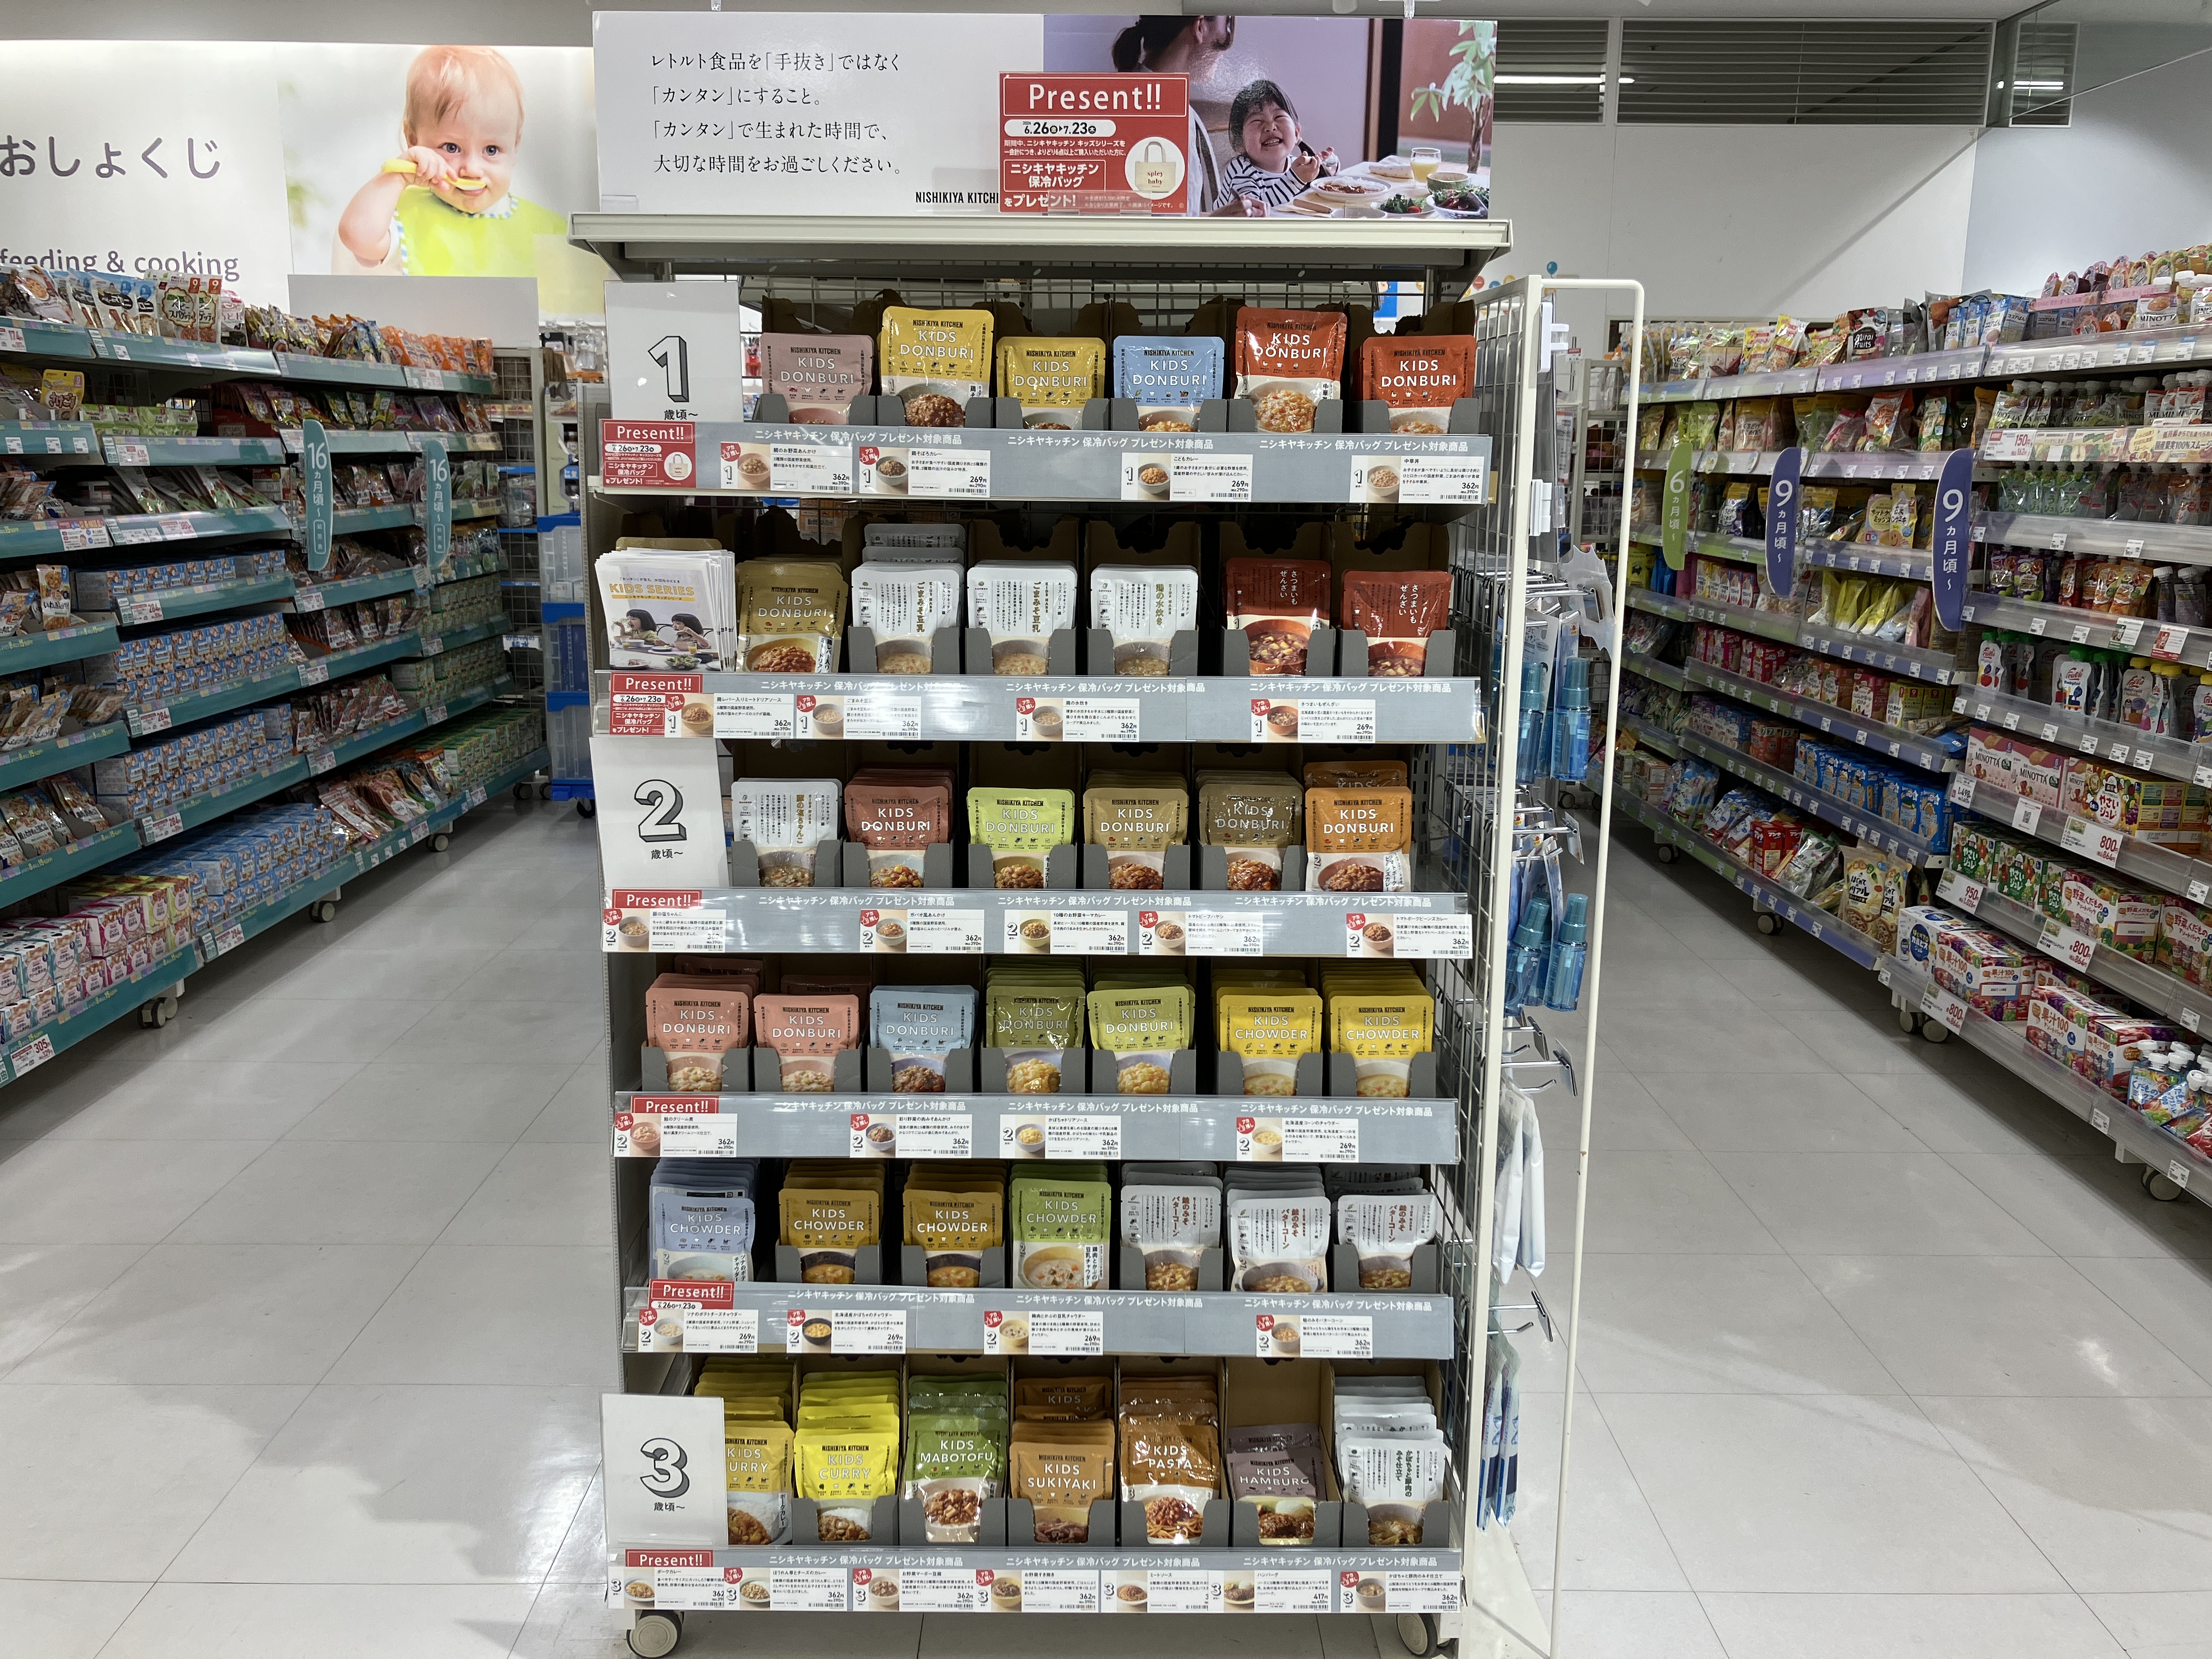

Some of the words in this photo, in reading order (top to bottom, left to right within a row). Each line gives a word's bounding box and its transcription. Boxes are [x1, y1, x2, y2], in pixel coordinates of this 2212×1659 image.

[652, 52, 899, 72] レトルト食品を「手抜き」ではなく
[654, 86, 819, 105] 「カンタン」にすること。
[1029, 84, 1161, 111] Present!!
[654, 121, 887, 139] 「カンタン」で生まれた時間で、
[0, 135, 220, 179] おしょくじ
[654, 154, 900, 174] 大切な時間をお過ごしください。
[1010, 163, 1099, 175] ニシキヤキッチン
[1029, 176, 1084, 188] 保冷バッグ
[916, 192, 964, 203] NISHIKIYA
[967, 192, 998, 204] KITCH
[1005, 194, 1076, 207] をプレゼント!
[107, 250, 125, 273] &
[134, 251, 240, 282] cooking
[918, 330, 957, 343] KIDS
[900, 344, 974, 360] DONBURI
[647, 335, 690, 402] 1
[798, 357, 836, 369] KIDS
[1150, 359, 1188, 371] KIDS
[780, 370, 855, 385] DONBURI
[1132, 374, 1206, 386] DONBURI
[617, 425, 685, 441] Present!!
[755, 430, 827, 441] ニシキヤキッチン
[830, 432, 877, 442] 保冷バッグ
[879, 432, 962, 445] プレゼント対象商品
[1260, 440, 1332, 450] ニシキヤキッチン
[1334, 440, 1381, 451] 保冷バッグ
[1384, 440, 1468, 452] プレゼント対象商品
[610, 583, 644, 594] KIDS
[647, 584, 695, 596] SERIES
[1279, 570, 1288, 599] ぜんざい
[776, 595, 811, 606] KIDS
[758, 608, 827, 618] DONBURI
[625, 677, 692, 691] Present!!
[1250, 682, 1320, 692] ニシキヤキッチン
[1322, 682, 1367, 692] 保冷バッグ
[1369, 682, 1451, 693] プレゼント対象商品
[634, 779, 687, 843] 2
[878, 807, 914, 818] KIDS
[1118, 808, 1153, 819] KIDS
[861, 820, 930, 831] DONBURI
[1100, 822, 1169, 833] DONBURI
[627, 895, 691, 907] Present!!
[997, 896, 1066, 906] ニシキヤキッチン
[1068, 896, 1111, 906] 保冷バッグ
[1114, 896, 1192, 906] プレゼント対象商品
[679, 1009, 715, 1020] KIDS
[1254, 1015, 1289, 1026] KIDS
[663, 1023, 730, 1035] DONBURI
[1234, 1028, 1308, 1040] CHOWDER
[646, 1101, 709, 1113] Present!!
[1008, 1102, 1075, 1111] ニシキヤキッチン
[1077, 1102, 1120, 1112] 保冷バッグ
[1121, 1103, 1198, 1113] プレゼント対象商品
[1045, 1200, 1078, 1210] KIDS
[687, 1213, 723, 1222] KIDS
[1026, 1213, 1097, 1223] CHOWDER
[670, 1223, 741, 1236] CHOWDER
[663, 1284, 724, 1299] Present!!
[1244, 1299, 1308, 1309] ニシキヤキッチン
[1312, 1299, 1354, 1310] 保冷バッグ
[1356, 1300, 1432, 1312] プレゼント対象商品
[940, 1440, 974, 1451] KIDS
[827, 1454, 863, 1465] KIDS
[920, 1452, 994, 1463] MABOTOFU
[640, 1437, 690, 1498] 3
[819, 1468, 871, 1479] CURRY
[1044, 1463, 1080, 1475] KIDS
[1256, 1466, 1290, 1476] KIDS
[1028, 1477, 1096, 1489] SUKIYAKI
[1240, 1476, 1310, 1486] HAMBURG
[640, 1554, 703, 1567] Present!!
[769, 1555, 837, 1565] ニシキヤキッチン
[839, 1555, 882, 1565] 保冷バッグ
[885, 1556, 963, 1567] プレゼント対象商品
